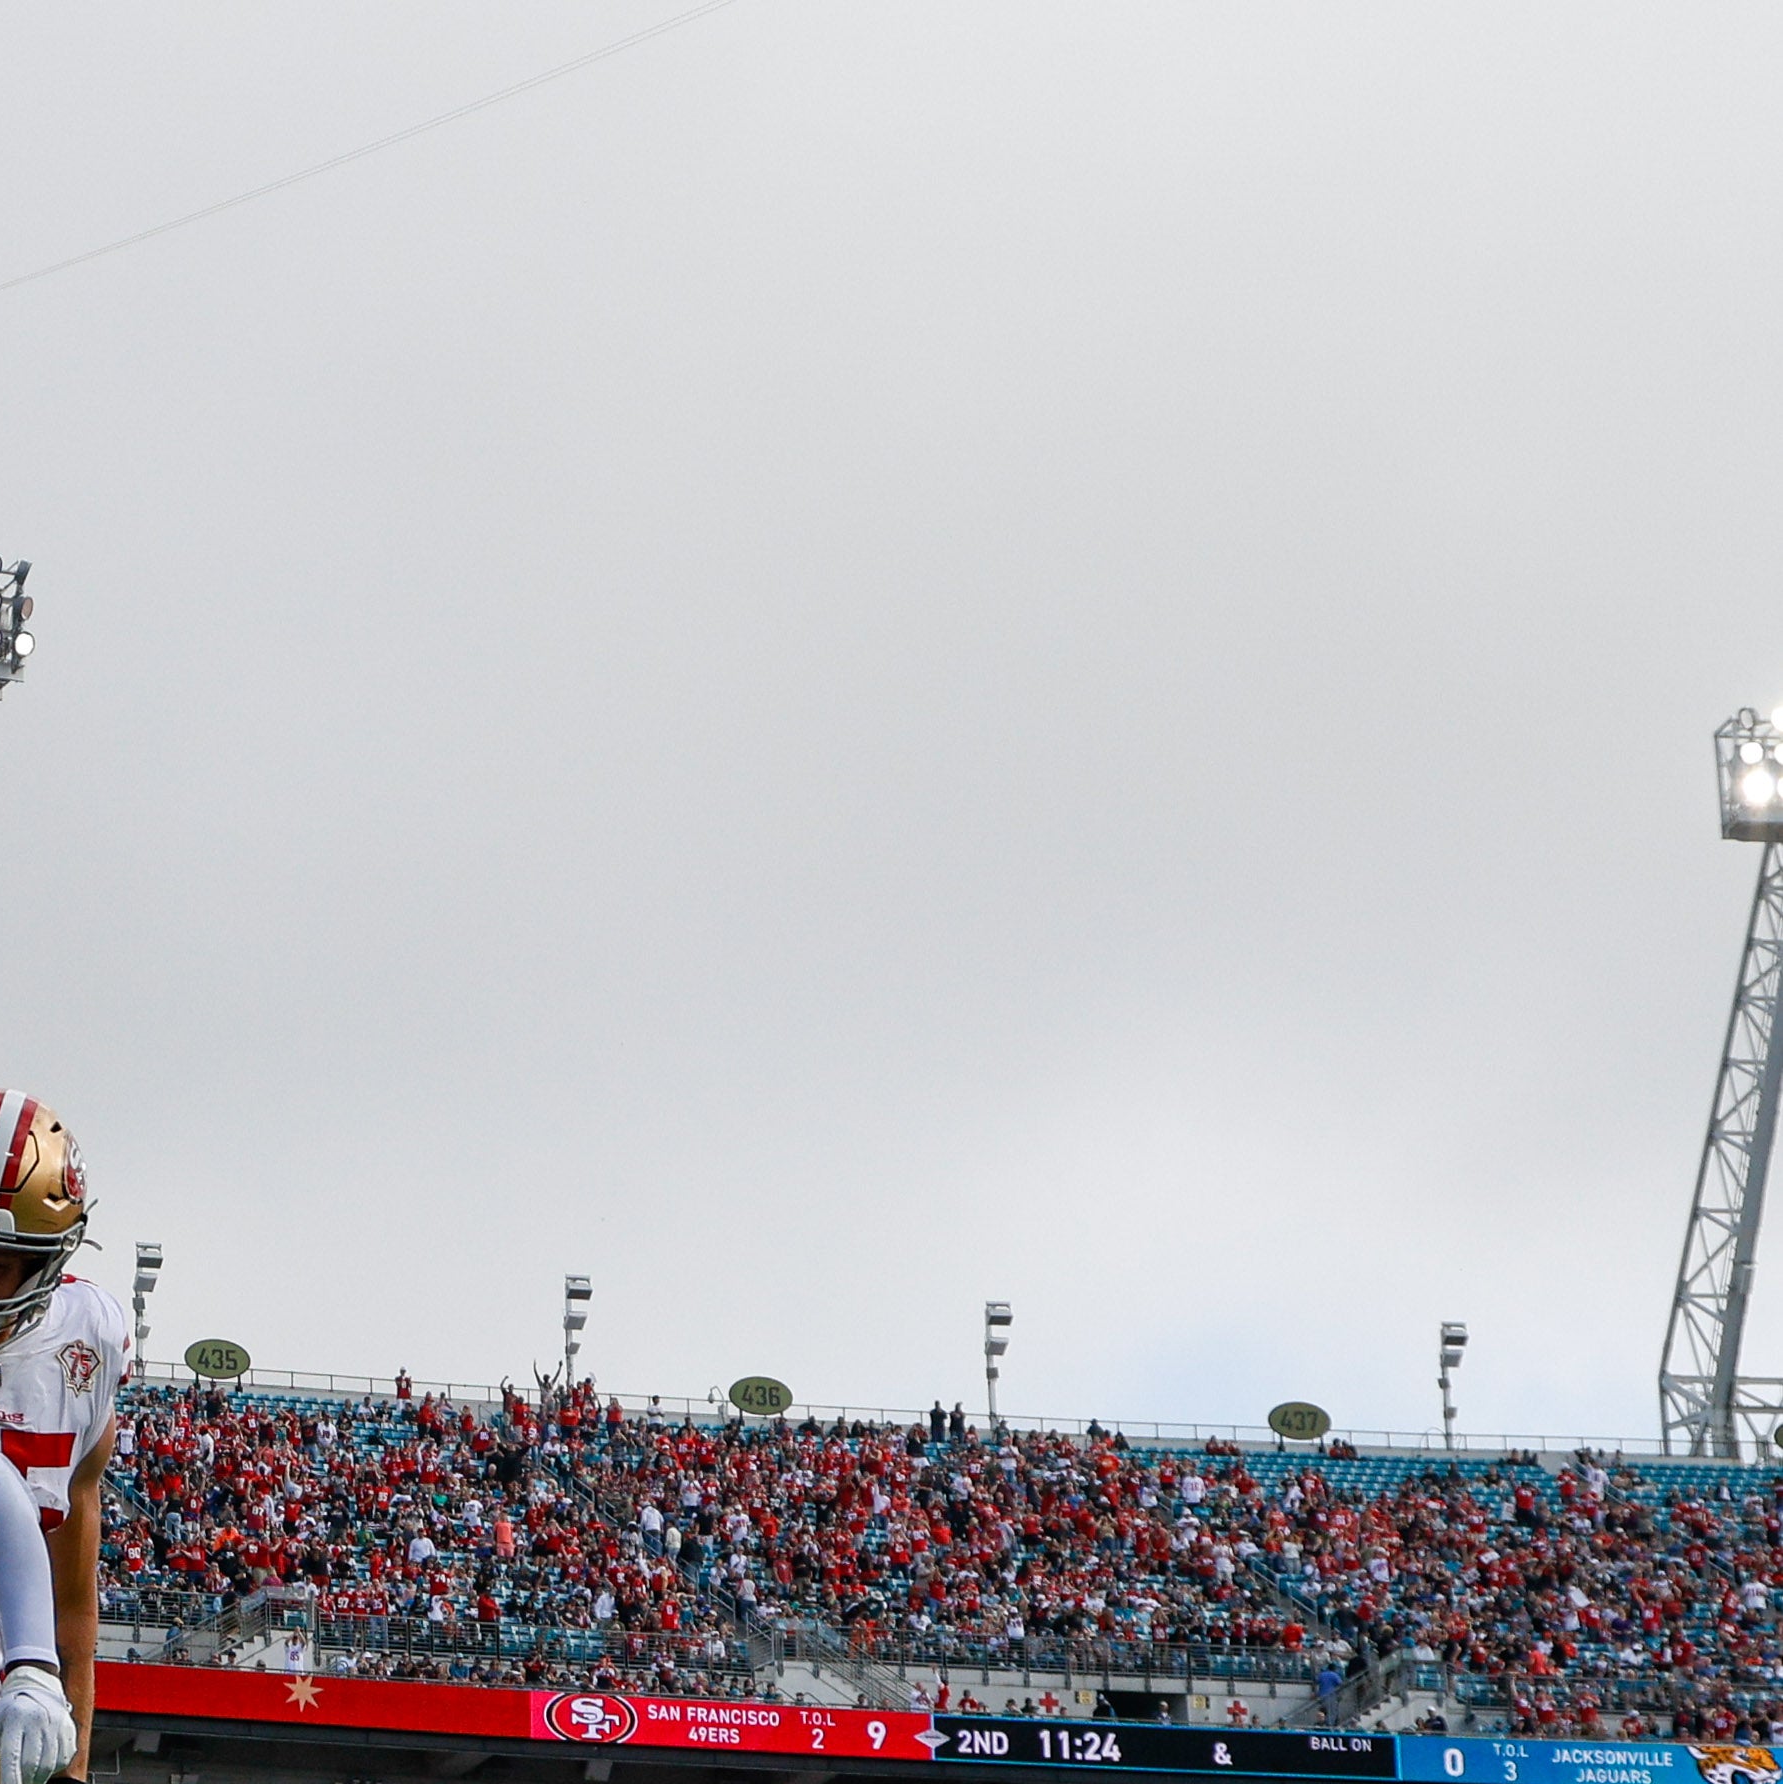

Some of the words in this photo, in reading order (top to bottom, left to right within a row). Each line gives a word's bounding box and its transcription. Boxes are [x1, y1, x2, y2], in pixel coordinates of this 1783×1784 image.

[70, 1353, 92, 1379] 75
[198, 1348, 239, 1370] 435
[742, 1386, 780, 1407] 436
[1280, 1412, 1318, 1432] 437
[648, 1705, 681, 1723] SAN
[685, 1708, 781, 1728] FRANCISCO
[689, 1727, 740, 1744] 49ERS
[811, 1729, 825, 1750] 2
[867, 1721, 887, 1750] 9
[957, 1729, 1009, 1755] 2ND
[1039, 1730, 1122, 1762] 11:24
[1311, 1735, 1349, 1752] BALL
[1352, 1737, 1372, 1753] ON
[1214, 1743, 1233, 1765] &
[1444, 1748, 1464, 1777] 0
[1552, 1748, 1674, 1767] JACKSONVILLE
[1505, 1761, 1518, 1782] 3
[1577, 1768, 1653, 1784] JAGUARS
